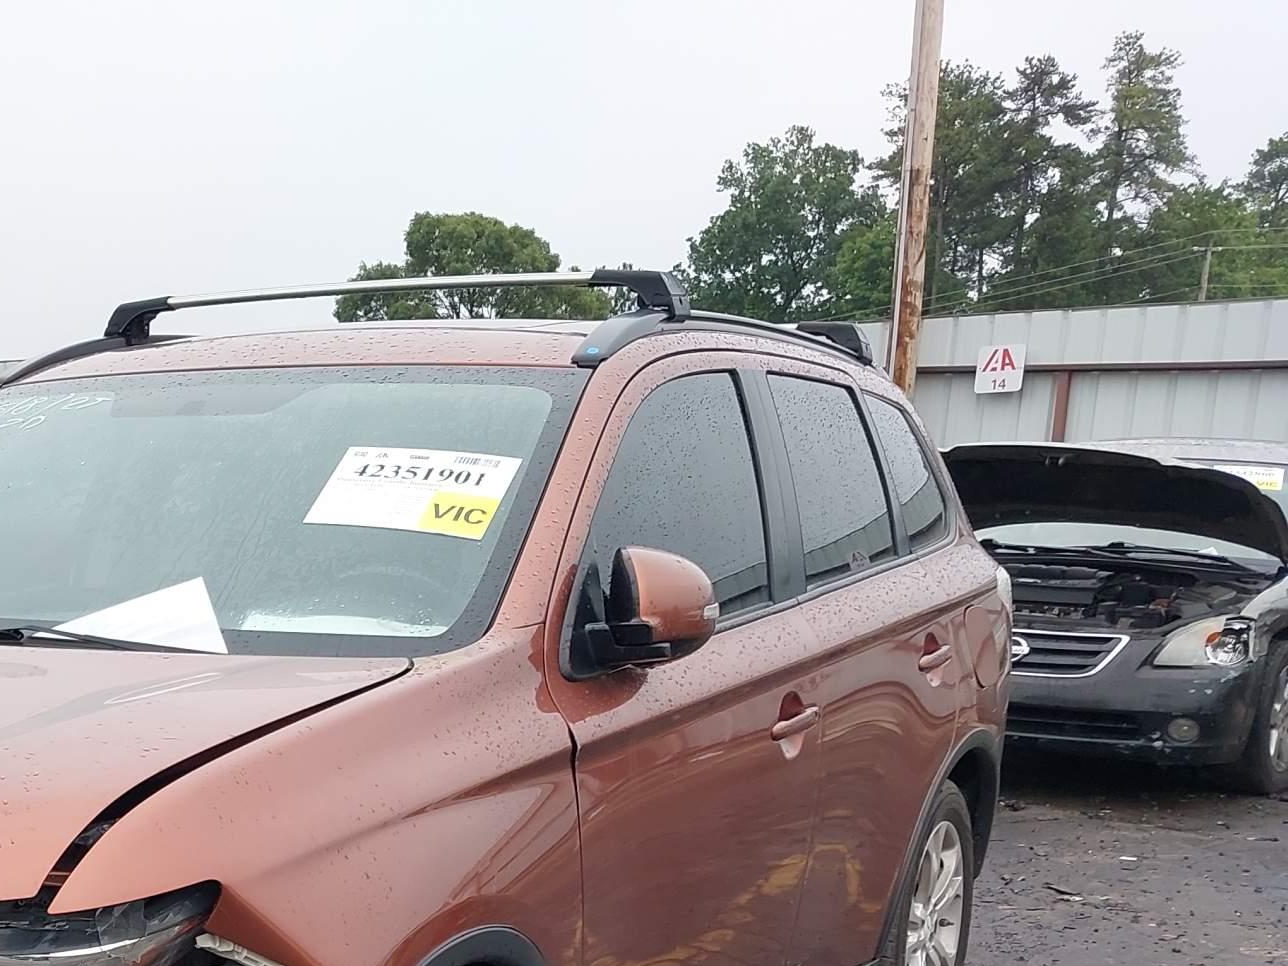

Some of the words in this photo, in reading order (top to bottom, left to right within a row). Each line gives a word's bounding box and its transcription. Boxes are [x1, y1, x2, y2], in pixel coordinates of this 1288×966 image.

[991, 378, 1006, 391] 14
[353, 463, 486, 486] 42351901
[433, 503, 488, 525] VIC
